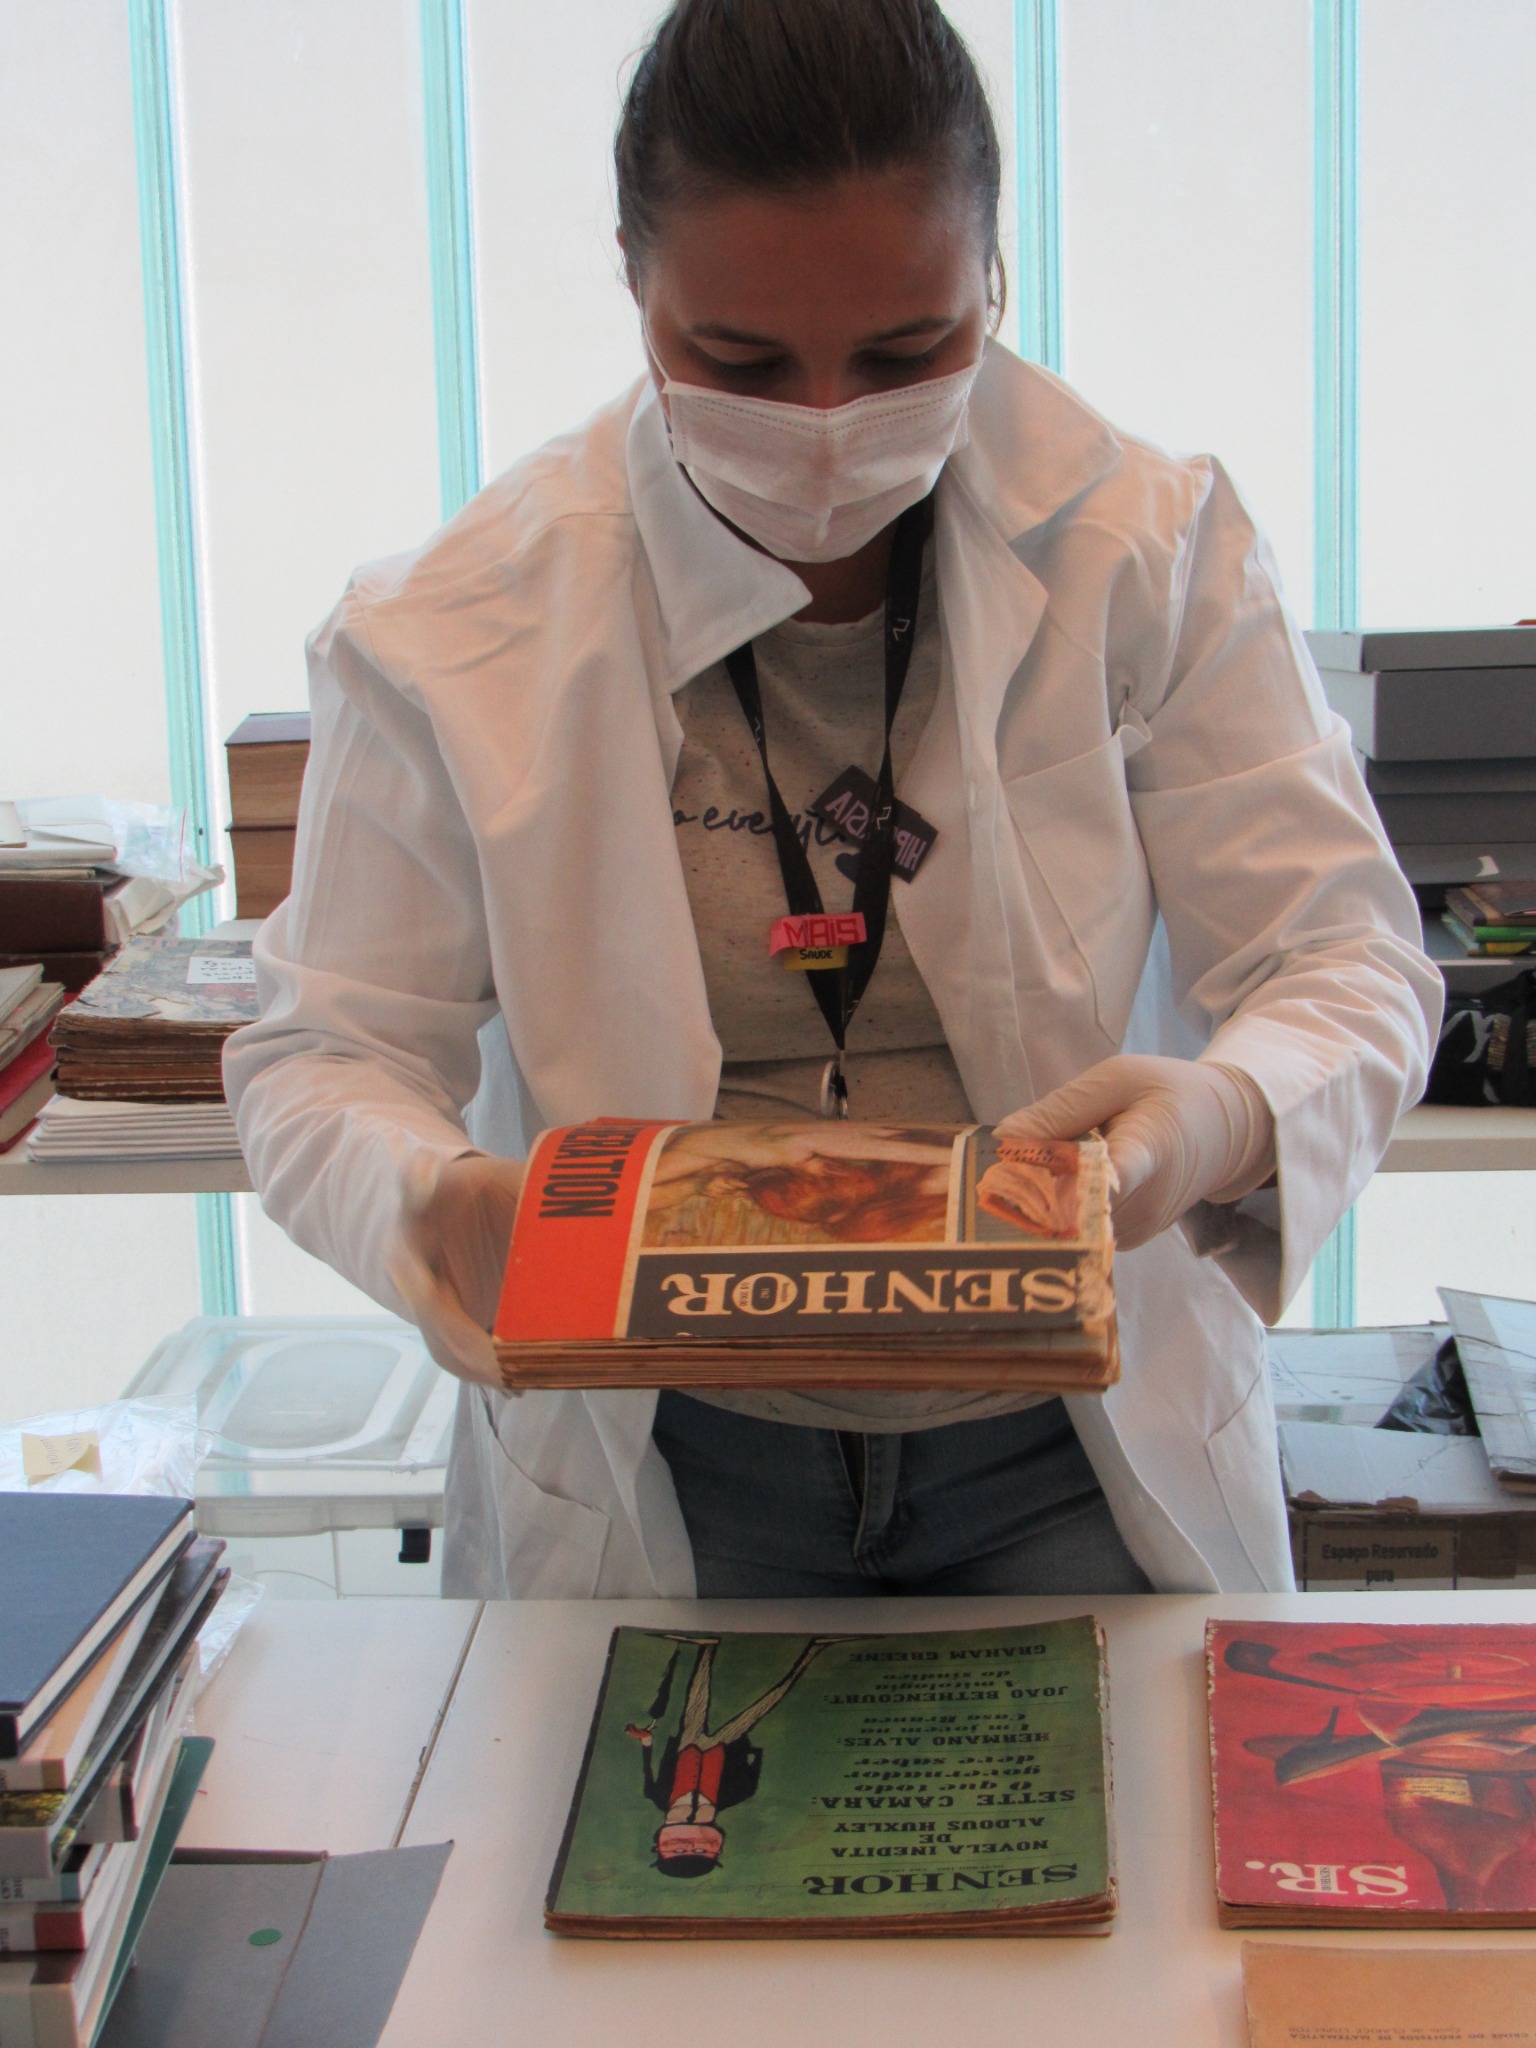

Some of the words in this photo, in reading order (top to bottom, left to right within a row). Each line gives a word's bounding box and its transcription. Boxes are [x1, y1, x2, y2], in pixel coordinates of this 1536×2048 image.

[539, 1127, 645, 1218] ERATION
[661, 1267, 1077, 1317] SENHOR
[1371, 1542, 1439, 1559] Reservado
[1366, 1569, 1394, 1586] para
[849, 1651, 939, 1662] GREENE
[949, 1644, 1046, 1659] GRAHAM
[875, 1681, 994, 1690] mitologia
[863, 1715, 957, 1724] Branca
[967, 1713, 1025, 1721] Casa
[900, 1724, 978, 1733] jovem
[932, 1732, 1050, 1746] HERMANO
[853, 1757, 946, 1767] saber
[958, 1754, 1035, 1764] deve
[844, 1765, 1041, 1780] governador
[854, 1784, 927, 1793] todo
[939, 1780, 998, 1791] que
[1009, 1781, 1032, 1790] O
[976, 1789, 1075, 1806] SETTE
[833, 1821, 936, 1832] HUXLEY
[947, 1817, 1045, 1830] ALDOUS
[919, 1833, 952, 1843] DE
[948, 1840, 1049, 1854] NOVELA
[802, 1863, 1078, 1896] SENHOR
